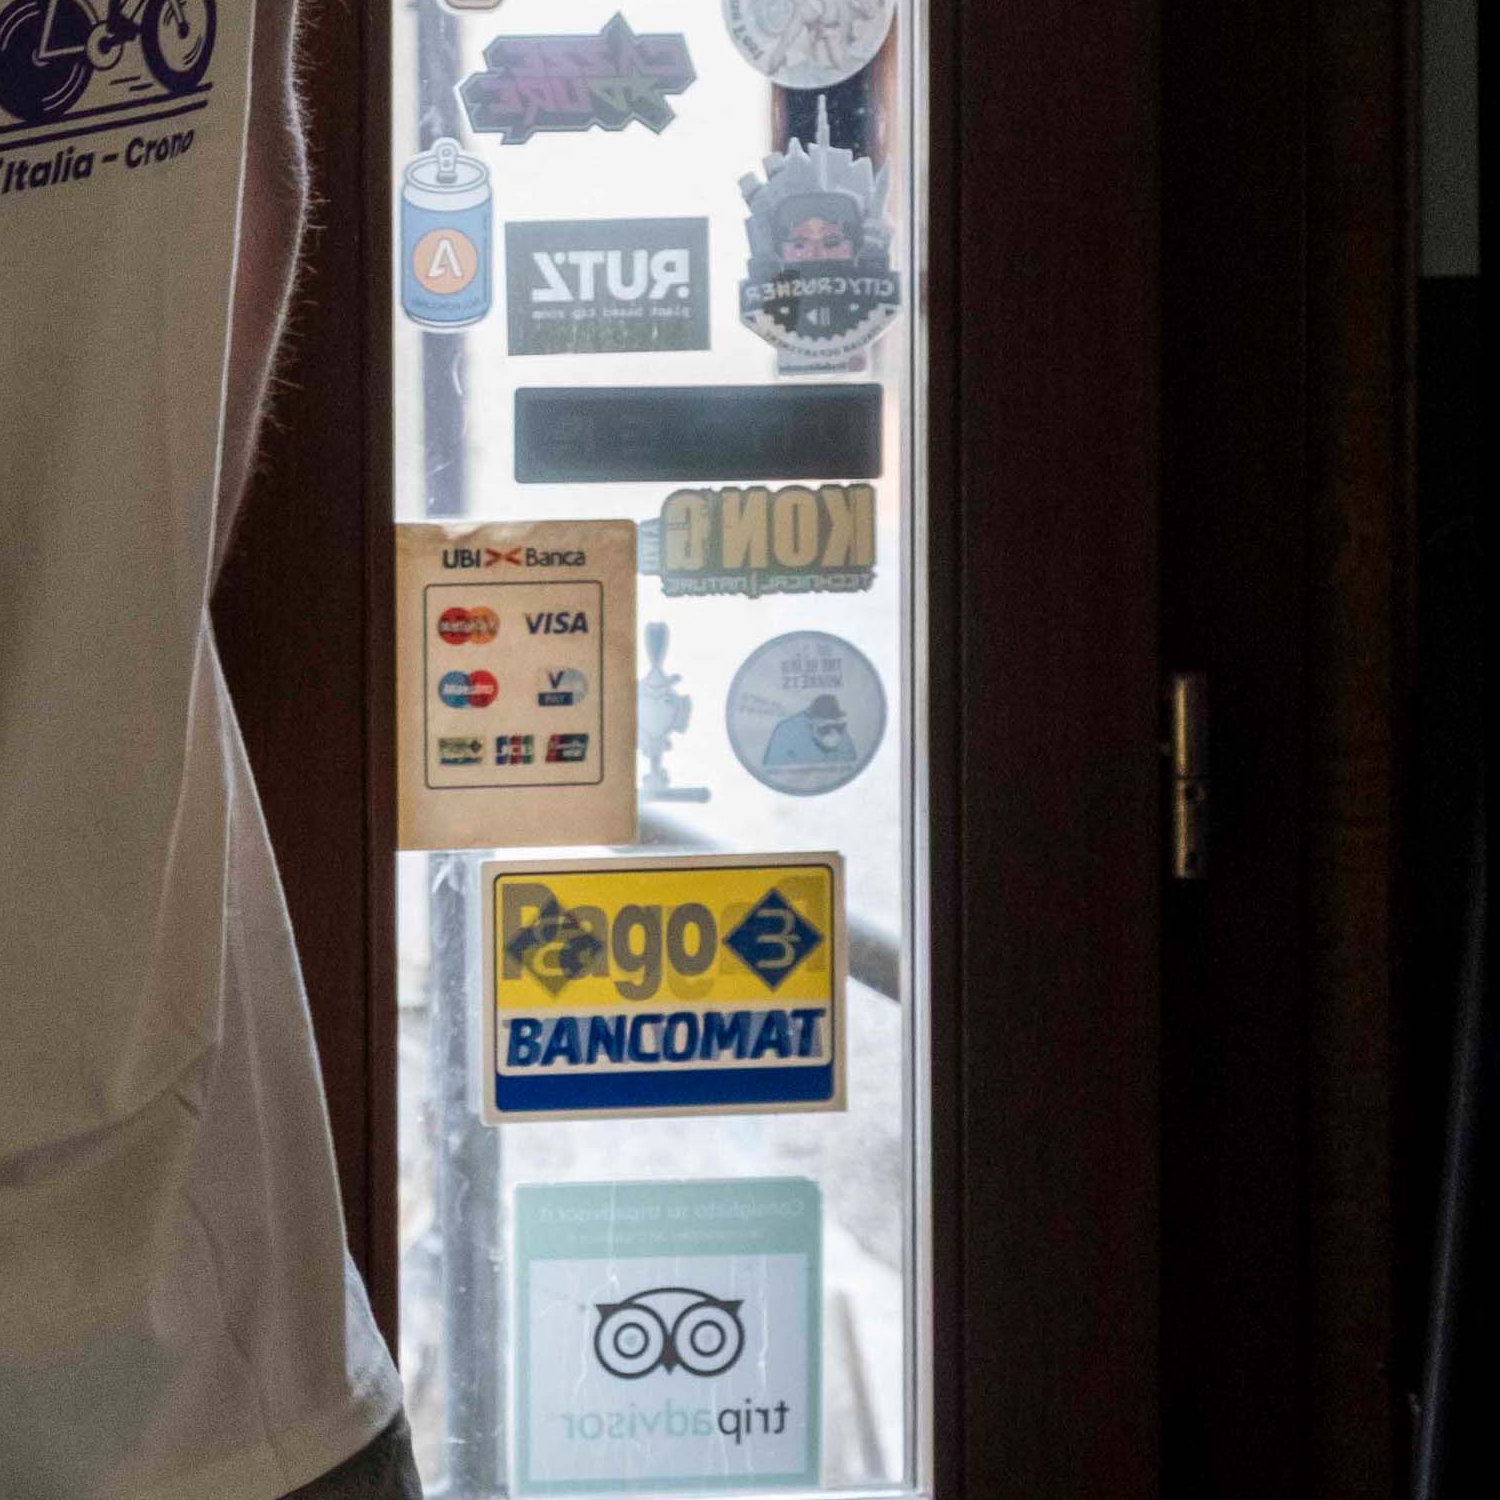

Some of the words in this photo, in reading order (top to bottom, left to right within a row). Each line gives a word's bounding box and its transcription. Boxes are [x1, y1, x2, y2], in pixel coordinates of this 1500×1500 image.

[124, 125, 195, 172] Crono
[442, 548, 481, 569] UBI
[526, 547, 586, 568] Banca
[526, 612, 589, 635] VISA
[502, 882, 718, 1001] Pago
[506, 1008, 827, 1068] BANCOMAT
